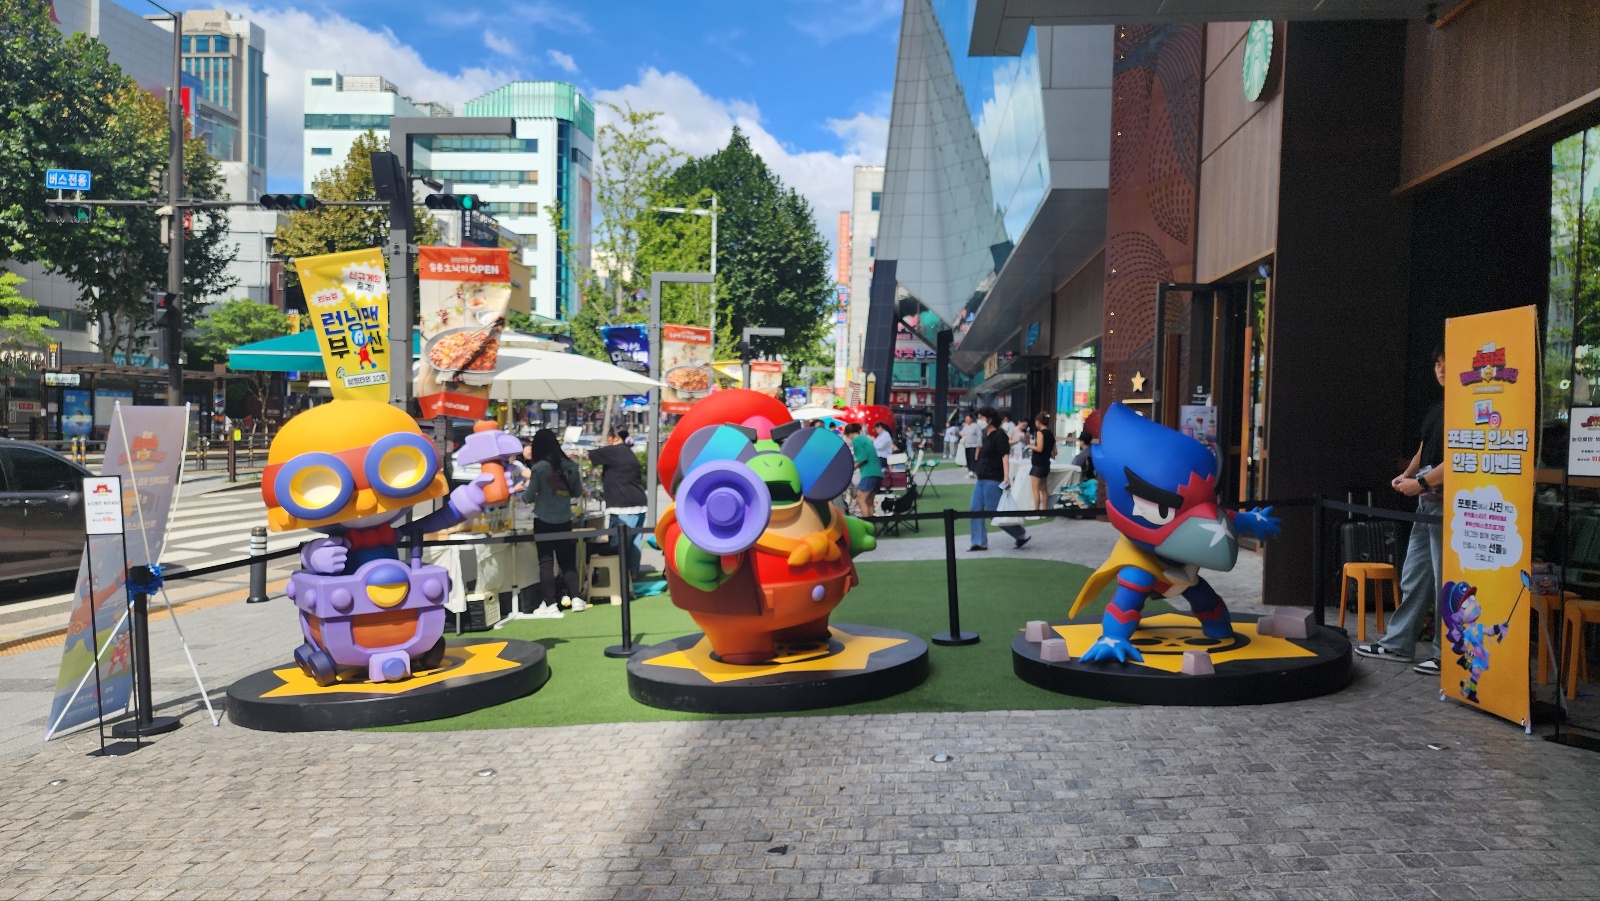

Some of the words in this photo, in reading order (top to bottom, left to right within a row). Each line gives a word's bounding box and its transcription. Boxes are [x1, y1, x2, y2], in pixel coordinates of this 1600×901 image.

[48, 172, 87, 187] 버스전용
[469, 264, 500, 275] OPEN
[349, 271, 382, 284] 신규게임
[317, 292, 338, 303] 리뉴얼
[320, 306, 380, 336] 런닝맨
[327, 330, 385, 359] 부산
[1447, 429, 1486, 450] 포토존
[1487, 429, 1529, 451] 인스타
[1452, 452, 1478, 472] 인증
[1481, 452, 1522, 475] 이벤트
[1457, 498, 1488, 511] 포토존에서
[1488, 501, 1503, 513] 사진
[1488, 542, 1507, 555] 선물을
